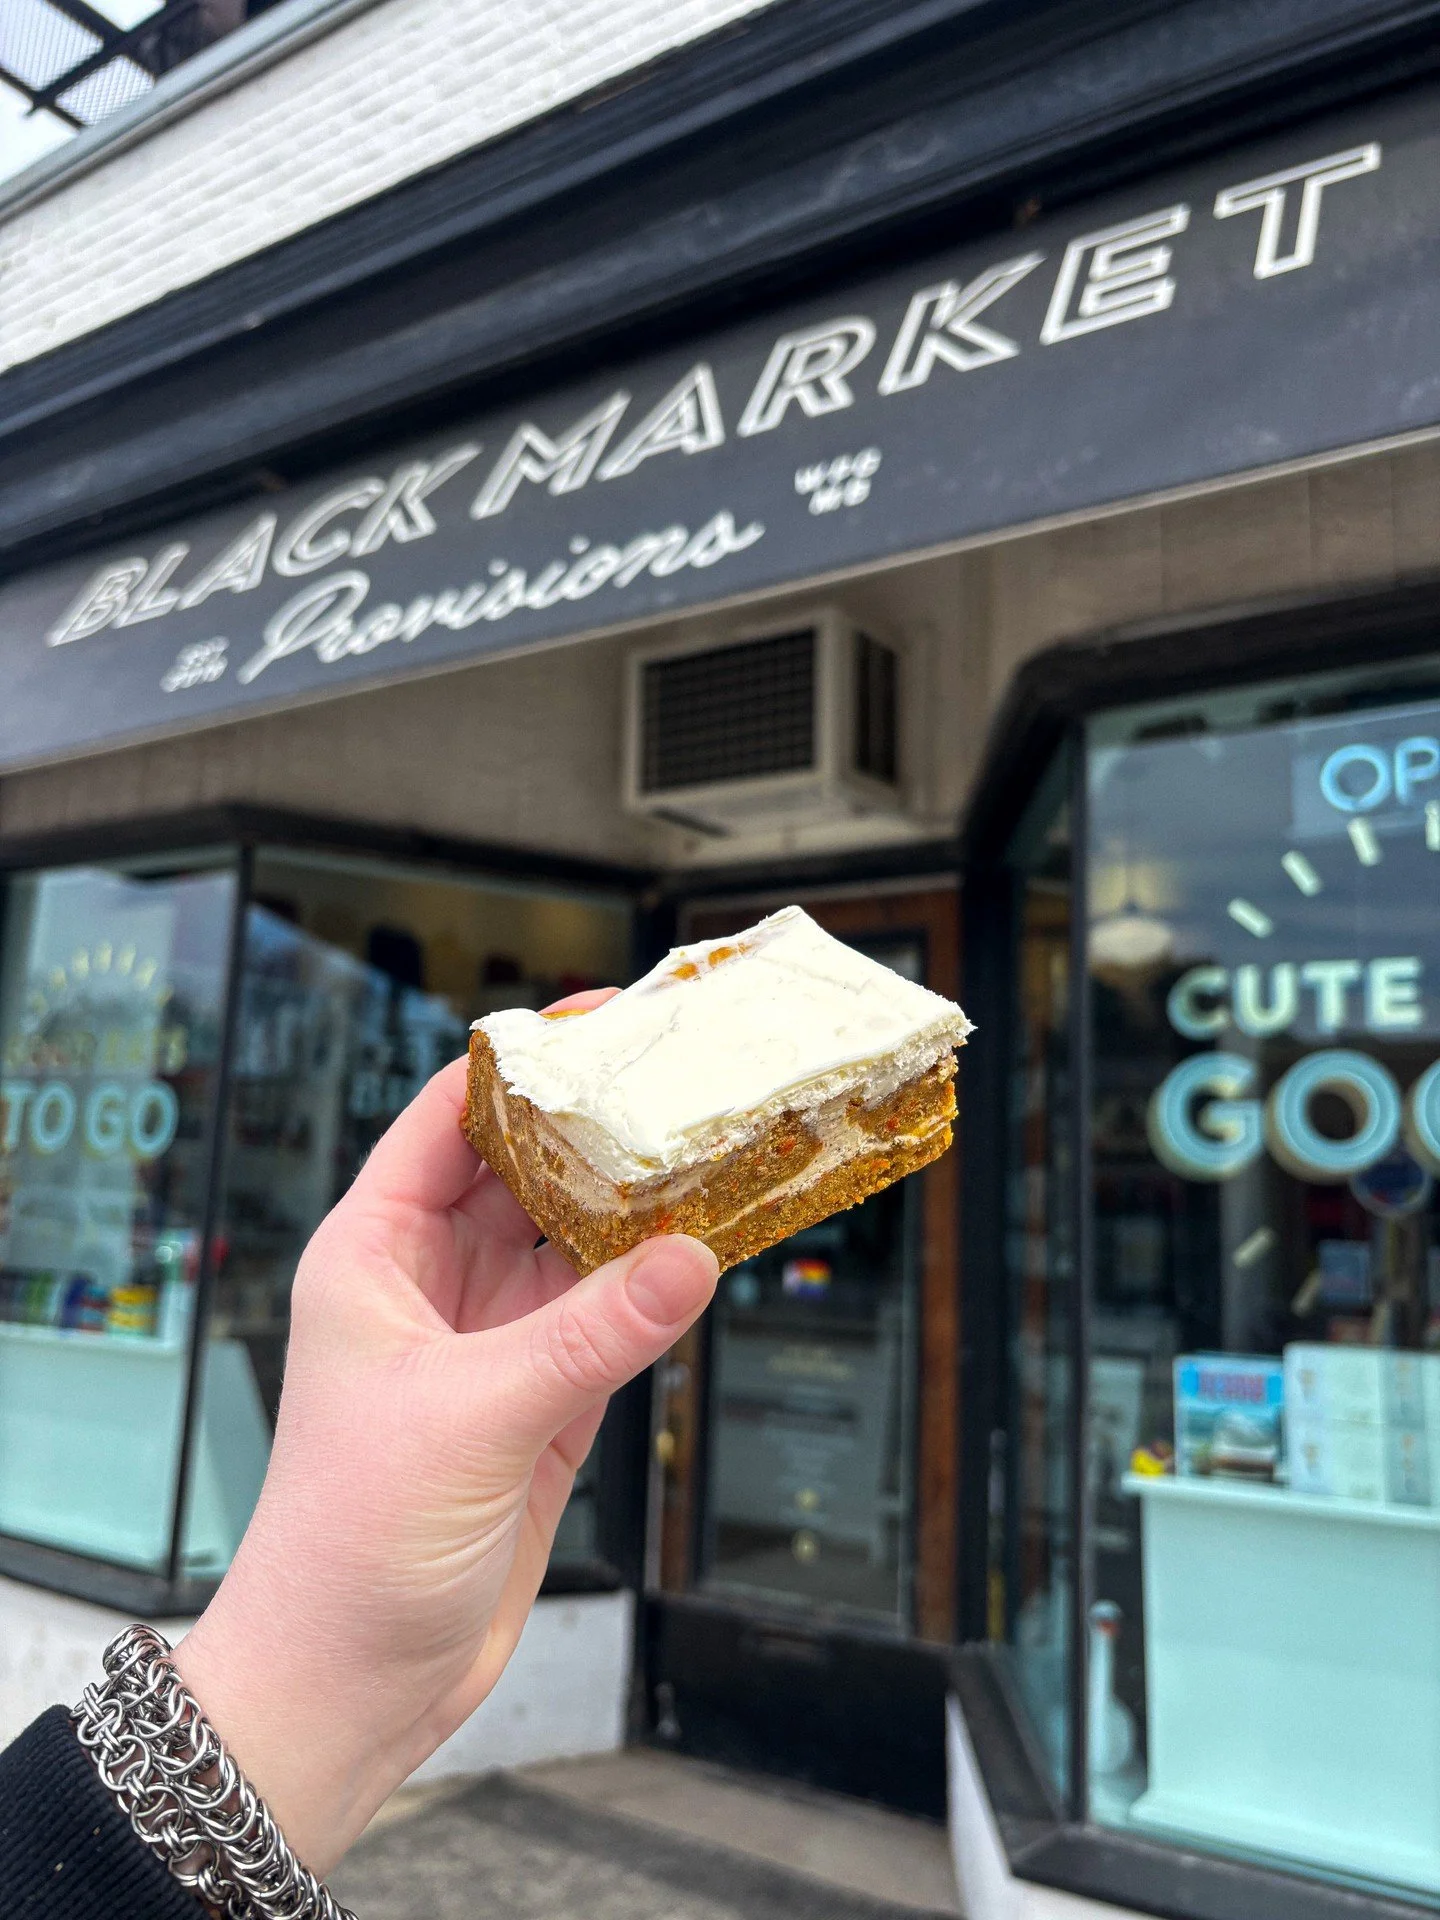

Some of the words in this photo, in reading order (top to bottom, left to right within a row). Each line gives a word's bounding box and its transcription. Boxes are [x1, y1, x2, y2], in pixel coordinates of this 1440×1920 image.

[46, 443, 483, 647] BLACK
[470, 142, 1382, 520] MARKET
[237, 510, 764, 684] Provisions
[1167, 957, 1424, 1040] CUTE
[2, 1079, 77, 1153] TO
[84, 1079, 180, 1158] GO
[1148, 1048, 1440, 1181] GO
